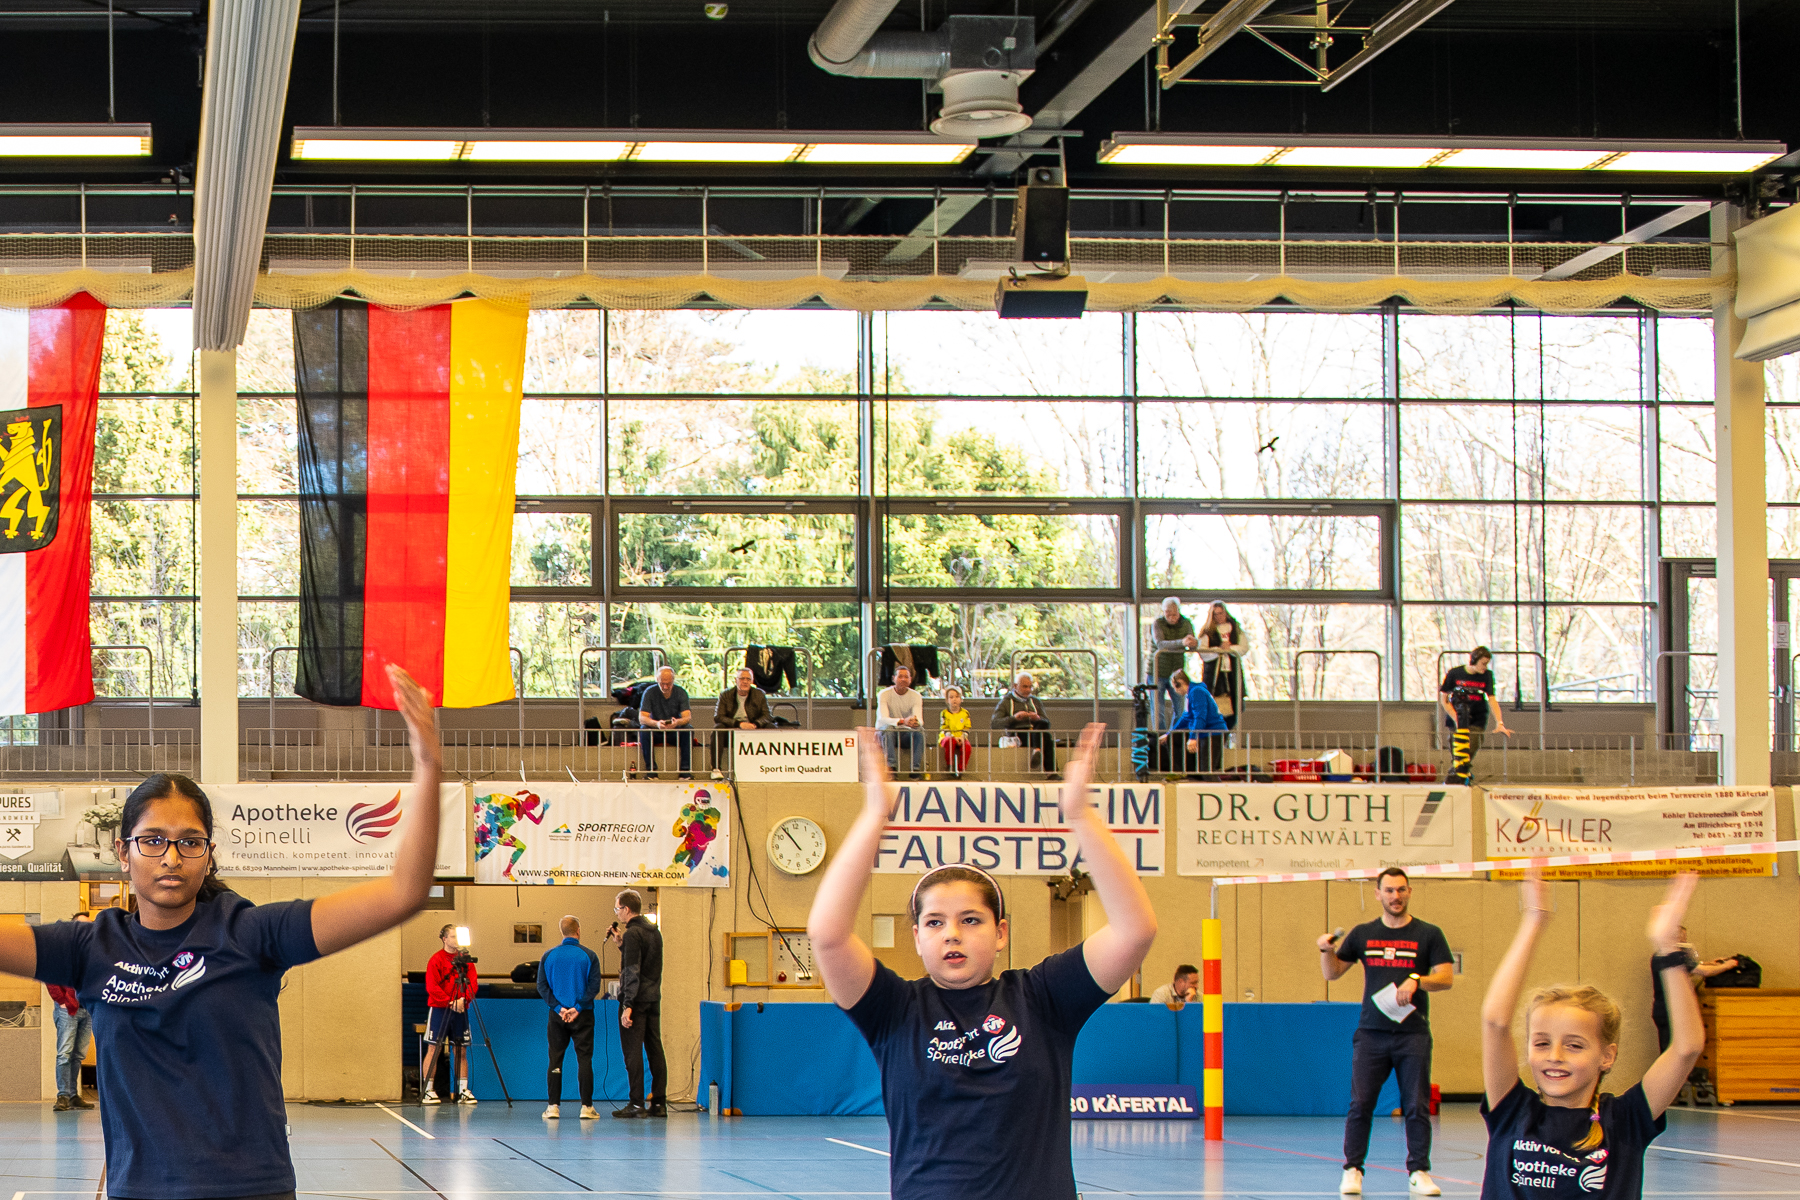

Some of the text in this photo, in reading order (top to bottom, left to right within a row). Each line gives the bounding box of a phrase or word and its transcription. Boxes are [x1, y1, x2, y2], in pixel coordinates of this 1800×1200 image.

[739, 742, 844, 756] MANNHEIM
[760, 765, 832, 774] Sport im Quadrat
[1197, 793, 1392, 823] DR. GUTH
[231, 804, 338, 825] Apotheke
[1688, 811, 1739, 819] Elektrotechnik
[577, 823, 655, 834] SPORTREGION
[1496, 814, 1612, 843] KÖHLER
[231, 827, 311, 848] Spinelli
[575, 833, 651, 843] Rhein-Neckar
[1197, 827, 1392, 846] RECHTSANWÄLTE
[231, 851, 398, 860] freundlich. kompetent. innovati
[873, 835, 1160, 871] FAUSTBL
[27, 862, 64, 873] Qualität.
[1197, 859, 1250, 869] Kompetent
[1290, 858, 1340, 868] Individuell
[517, 869, 685, 879] WWW.SPORTREGION-RHEIN-NECKAR.COM
[1091, 1093, 1194, 1113] KÄFERTAL
[1513, 1140, 1541, 1152] Aktiv
